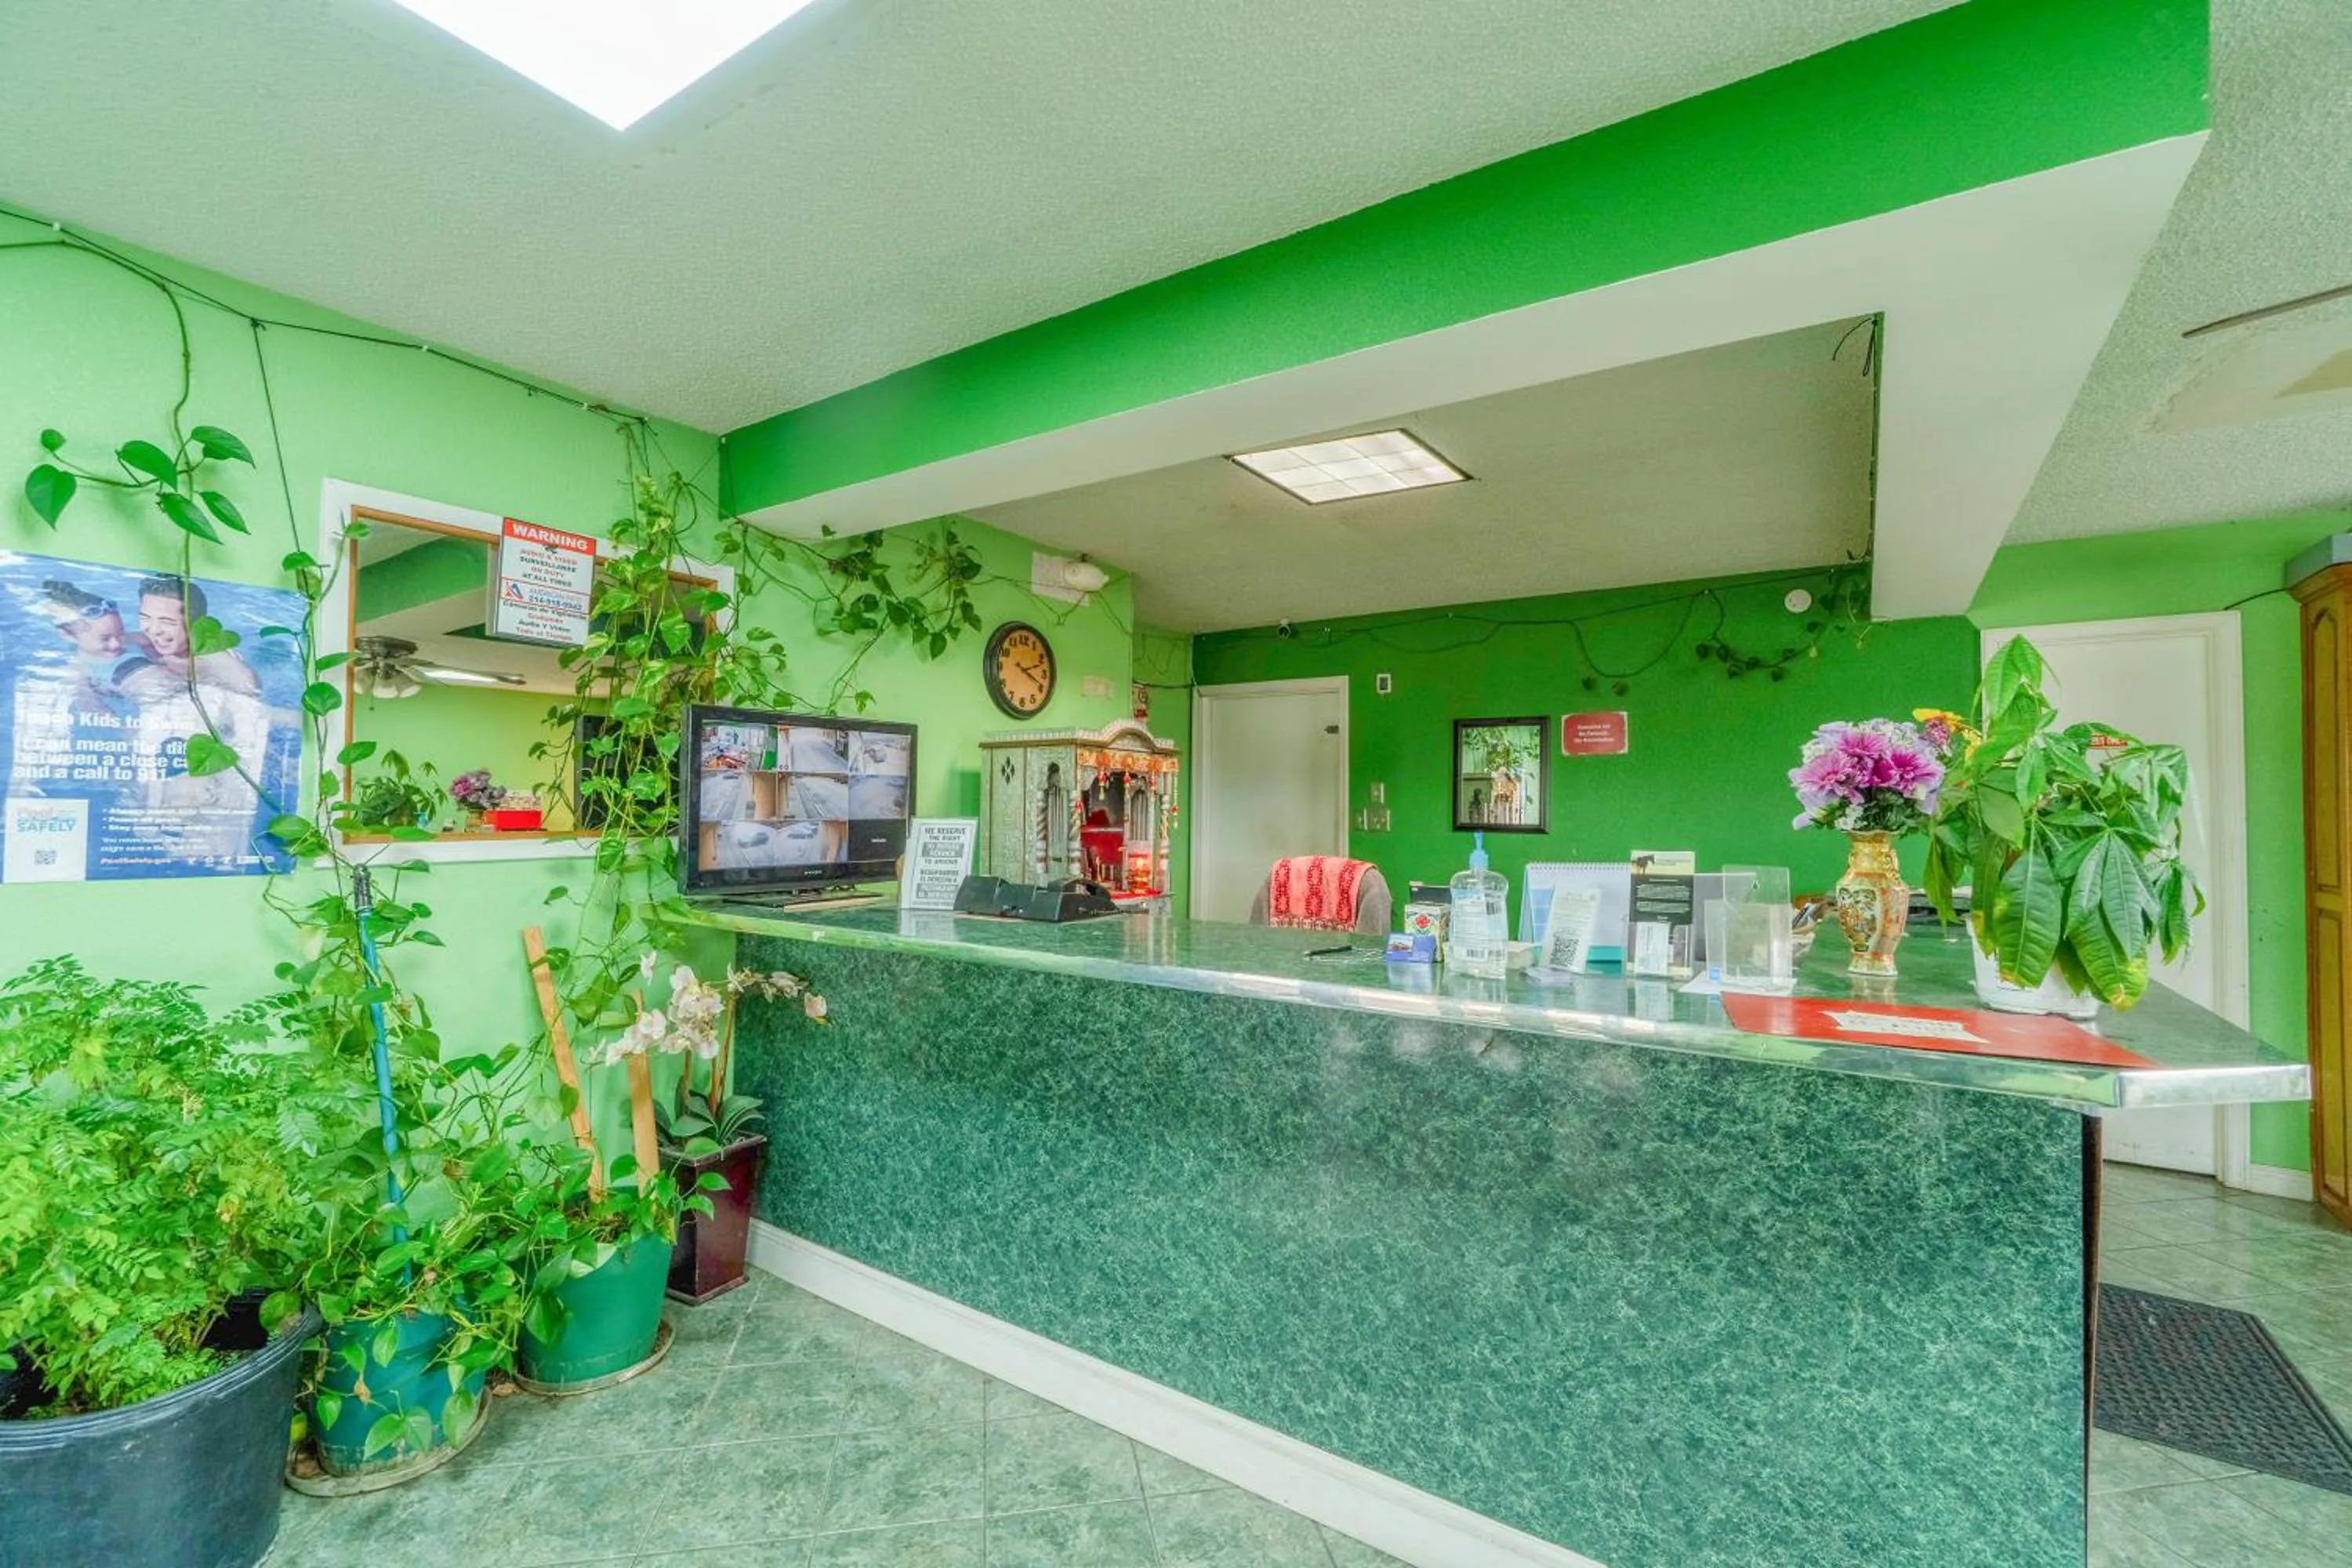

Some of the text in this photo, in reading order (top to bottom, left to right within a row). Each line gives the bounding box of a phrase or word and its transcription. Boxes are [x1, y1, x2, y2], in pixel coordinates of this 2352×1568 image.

[513, 523, 588, 550] WARNING
[1008, 637, 1018, 648] 11
[1018, 634, 1029, 647] 12
[1039, 653, 1044, 665] 2
[1041, 669, 1047, 680] 3
[1009, 690, 1014, 701] 7
[1030, 694, 1036, 703] 5
[1019, 697, 1025, 707] 6
[80, 713, 121, 728] Kids
[125, 714, 143, 728] to
[76, 739, 128, 752] mean
[14, 752, 97, 766] between
[103, 755, 114, 766] a
[120, 753, 169, 768] close
[14, 764, 49, 779] and
[54, 768, 67, 779] a
[74, 765, 110, 779] call
[113, 768, 132, 780] to
[17, 821, 75, 832] SAFELY
